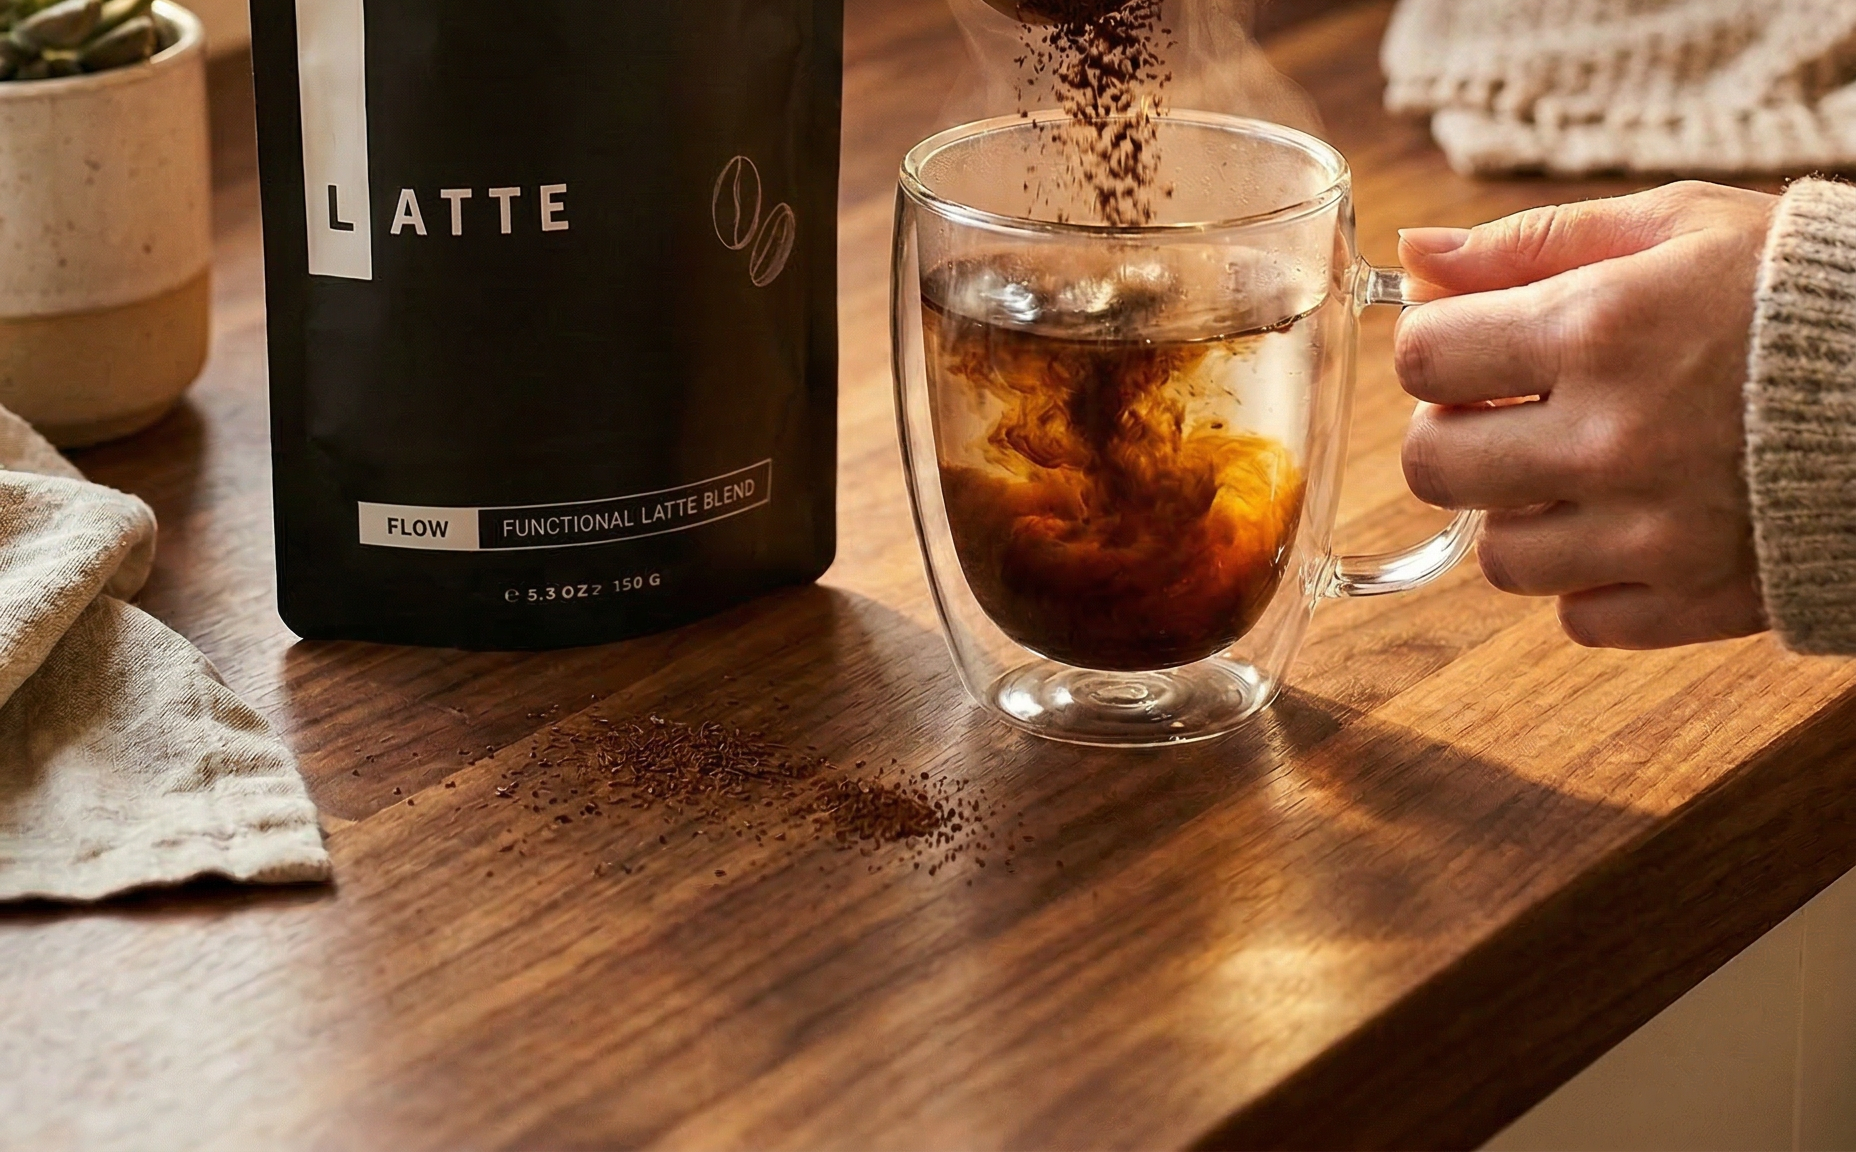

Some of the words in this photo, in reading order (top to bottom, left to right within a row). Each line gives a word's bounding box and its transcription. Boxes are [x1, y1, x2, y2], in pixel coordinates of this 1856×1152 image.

[503, 510, 634, 538] FUNCTIONAL
[641, 496, 698, 524] LATTE
[704, 478, 755, 510] BLEND
[387, 517, 449, 539] FLOW
[527, 588, 556, 602] 5.3
[613, 576, 643, 592] 150
[649, 573, 661, 586] G
